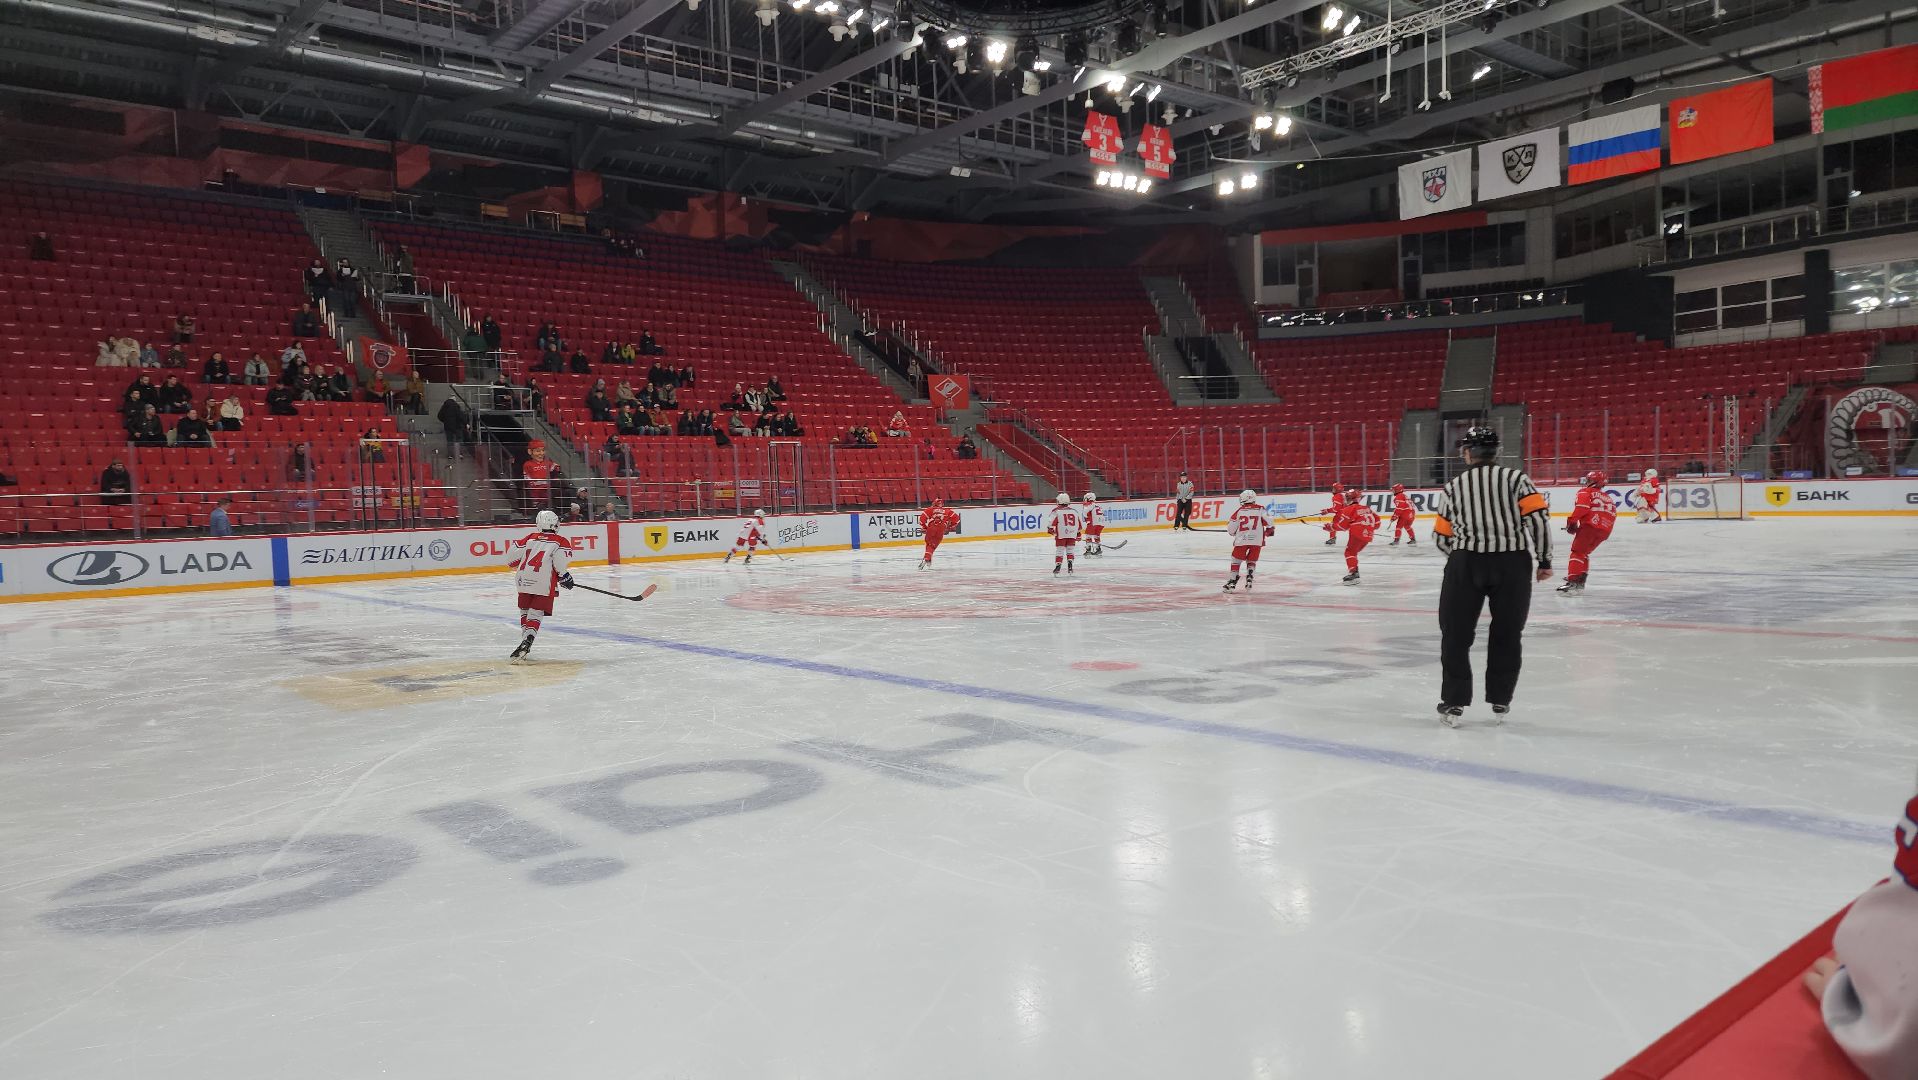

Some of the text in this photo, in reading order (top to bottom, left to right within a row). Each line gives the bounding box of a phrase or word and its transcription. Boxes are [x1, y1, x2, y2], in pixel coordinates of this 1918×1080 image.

[1099, 134, 1107, 151] 3
[1153, 145, 1161, 161] 5
[1423, 167, 1446, 179] МХЛ
[1797, 490, 1850, 501] БАНК
[1155, 499, 1225, 523] FOBET
[993, 509, 1042, 533] Haier
[1063, 513, 1076, 527] 19
[1238, 515, 1260, 532] 27
[673, 529, 720, 543] БАНК
[321, 544, 424, 564] БАЛТИКА
[469, 535, 599, 558] OLIET
[159, 551, 253, 575] LADA
[519, 548, 546, 573] 14
